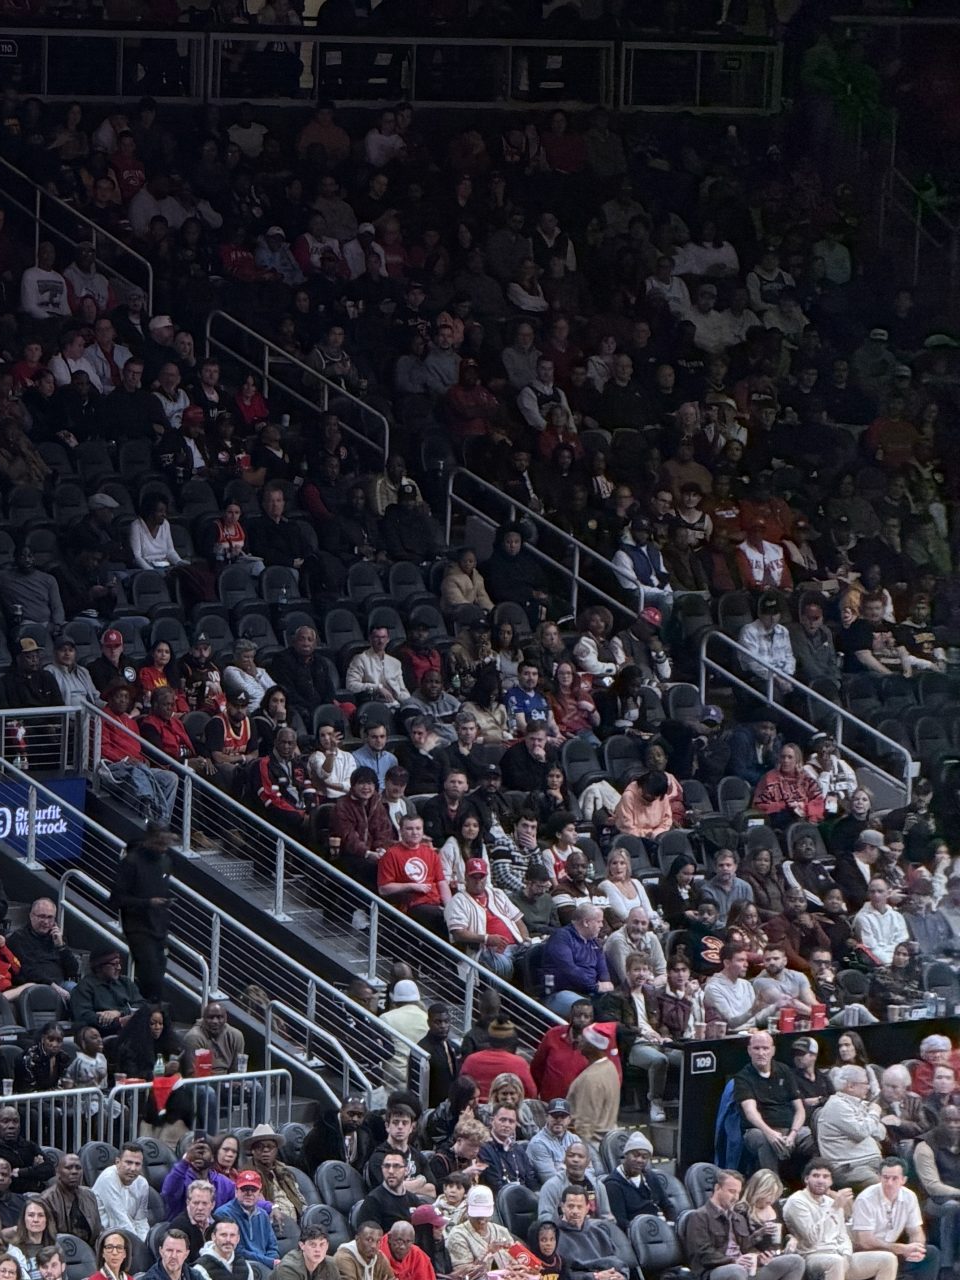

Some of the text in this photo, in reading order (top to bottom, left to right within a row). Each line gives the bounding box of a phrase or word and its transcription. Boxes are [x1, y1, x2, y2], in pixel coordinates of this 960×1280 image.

[15, 805, 61, 822] Surfit
[15, 819, 67, 836] Wetrock
[695, 1057, 711, 1068] 109
